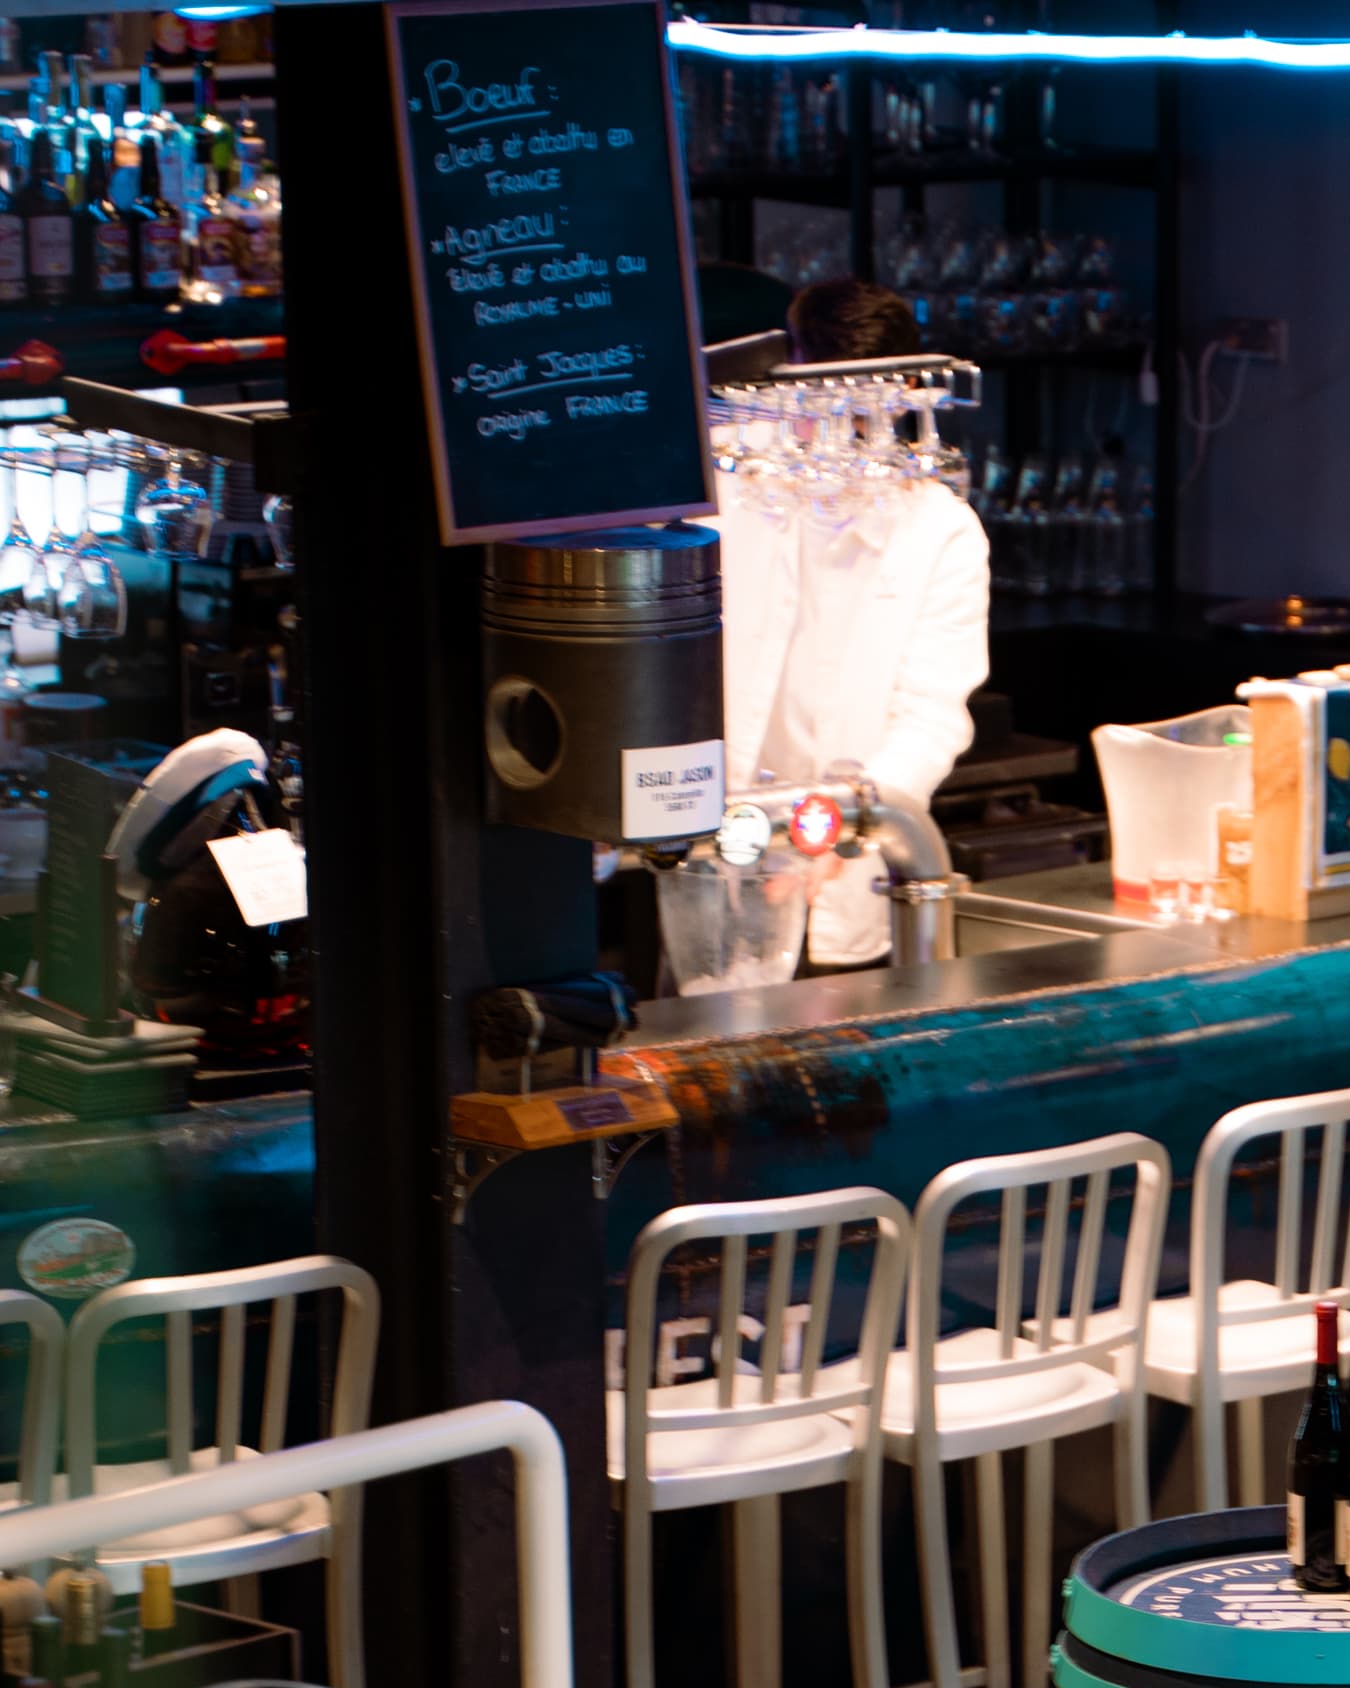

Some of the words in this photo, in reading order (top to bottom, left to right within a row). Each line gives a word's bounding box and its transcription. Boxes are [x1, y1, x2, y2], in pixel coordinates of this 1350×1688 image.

[527, 121, 600, 155] abattu
[539, 251, 609, 283] abattu
[564, 390, 649, 420] FRANCE
